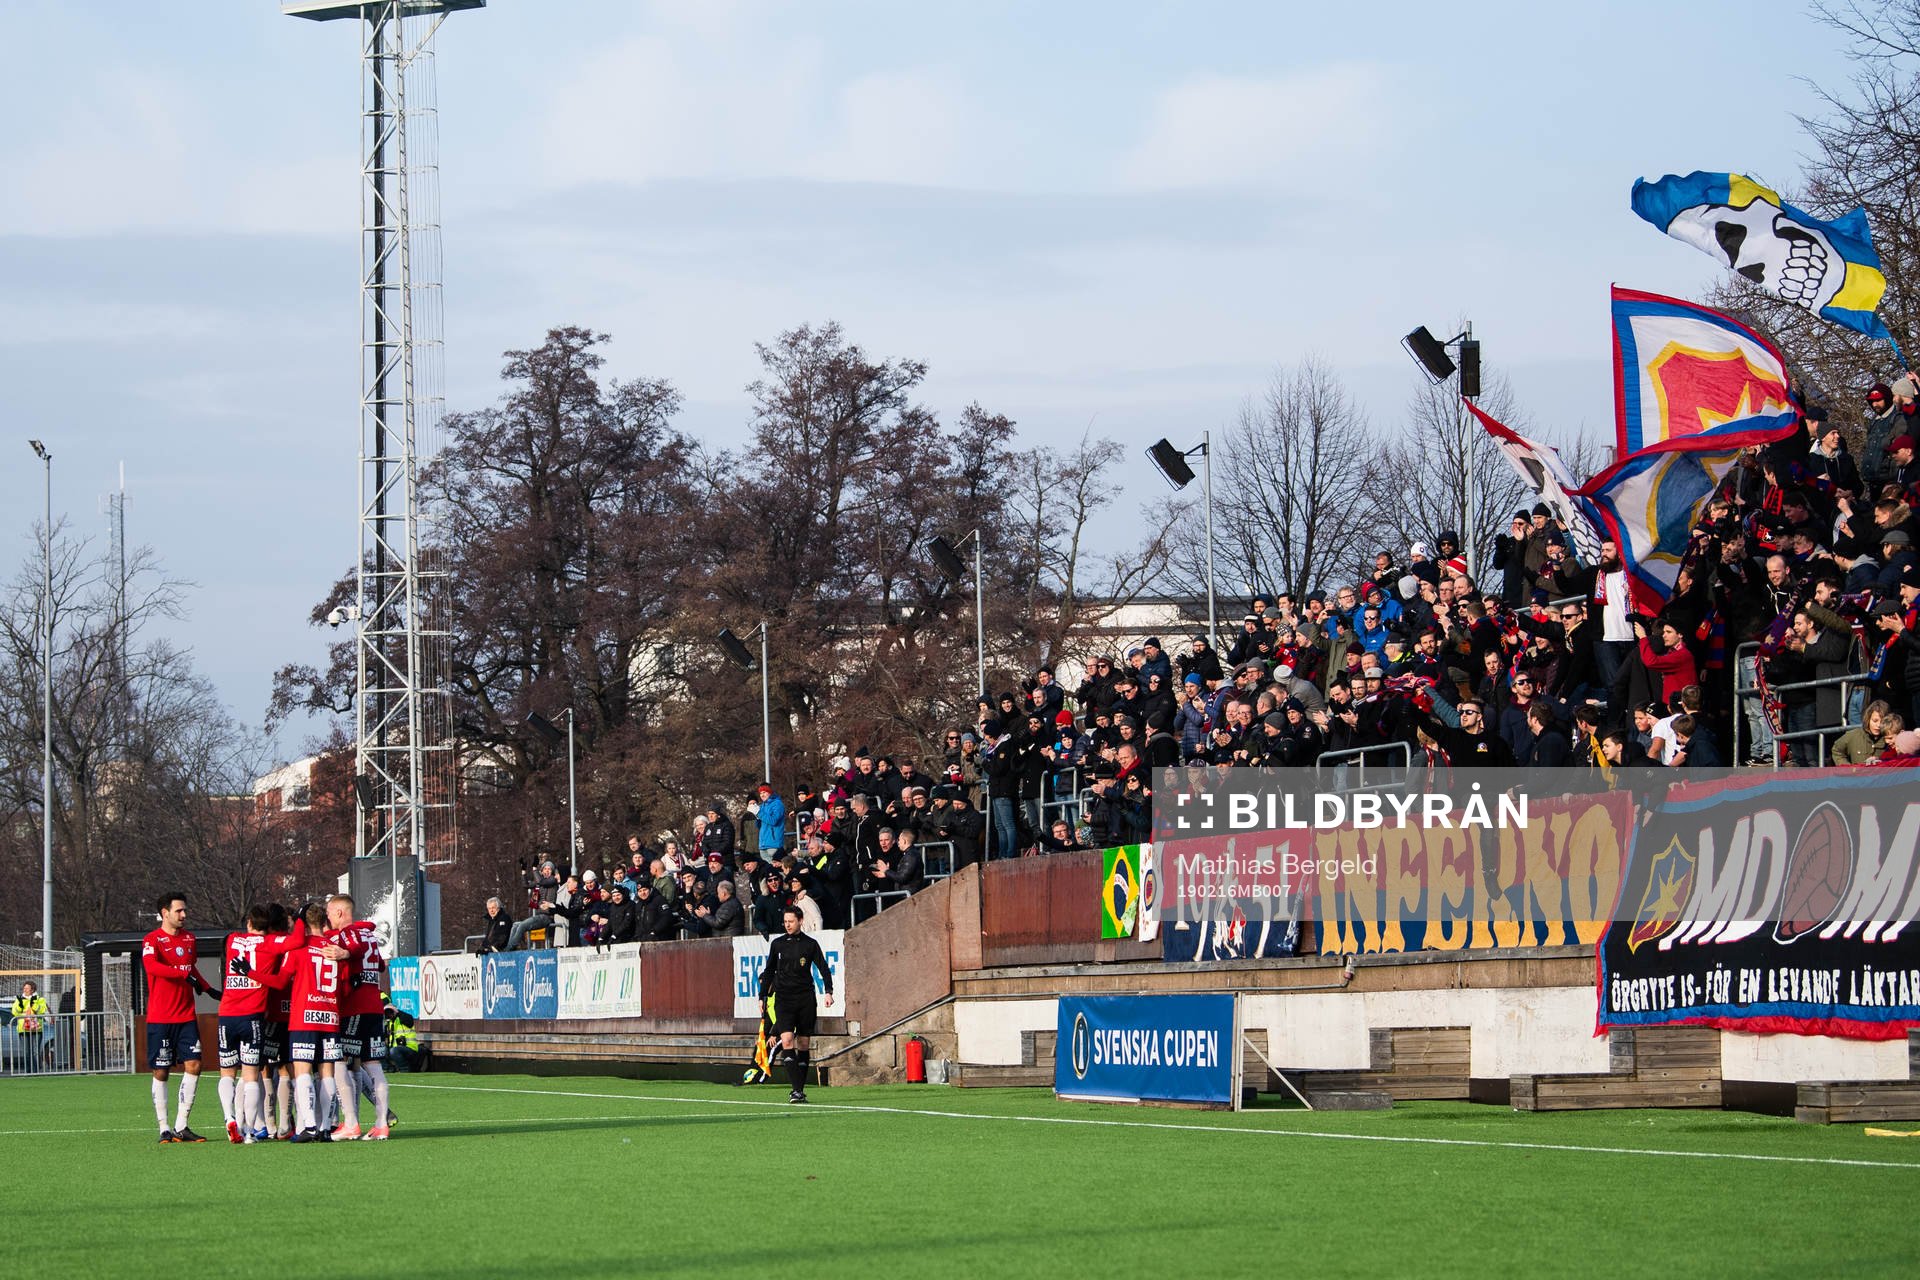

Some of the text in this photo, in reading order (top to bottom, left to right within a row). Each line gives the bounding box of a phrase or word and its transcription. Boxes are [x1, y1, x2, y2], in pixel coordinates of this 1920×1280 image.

[226, 976, 249, 988] BESAB
[312, 956, 338, 993] 13
[1612, 973, 1675, 1012] ÖRGRYTE
[1705, 963, 1731, 1004] FÖR
[1739, 968, 1761, 1003] EN
[1768, 968, 1841, 1004] LEVANDE
[305, 1011, 331, 1023] BESAB
[1094, 1029, 1218, 1067] SVENSKA CUPEN
